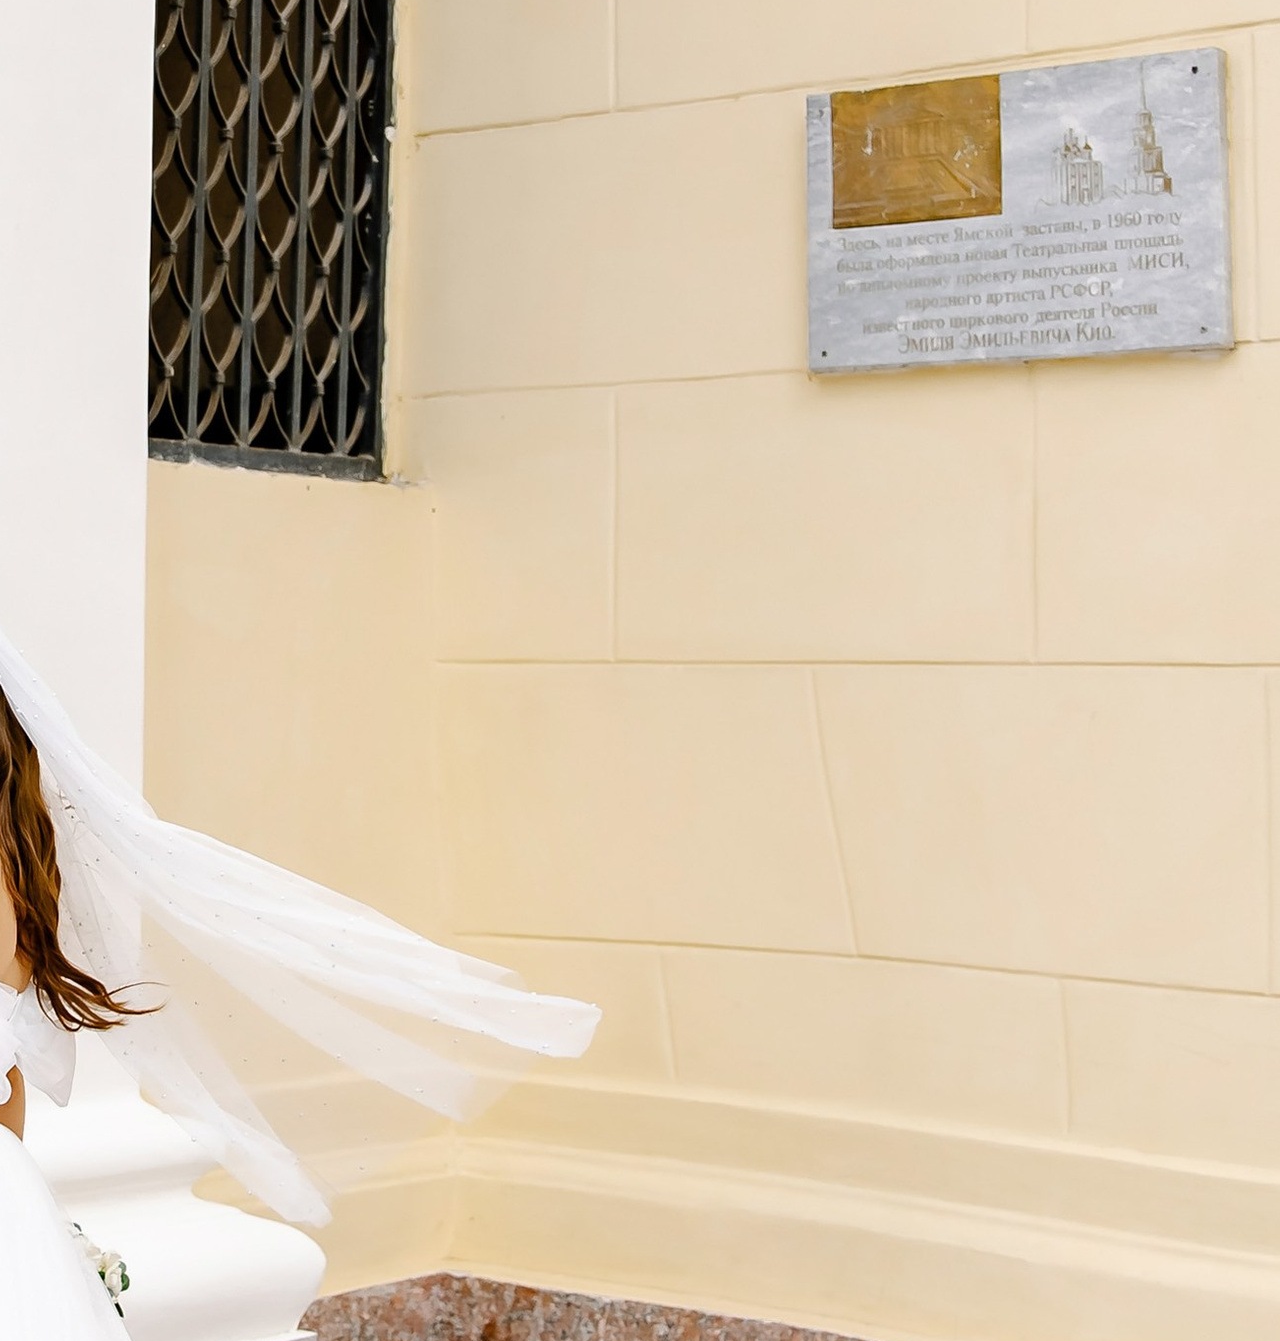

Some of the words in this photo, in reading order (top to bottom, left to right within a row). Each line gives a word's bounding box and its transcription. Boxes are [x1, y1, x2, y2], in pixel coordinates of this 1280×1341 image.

[906, 233, 950, 246] месте
[954, 227, 1013, 242] Ямской
[1093, 219, 1101, 230] в
[1108, 212, 1142, 228] 1960
[965, 248, 1008, 262] новая
[1012, 240, 1108, 258] Театральная
[956, 269, 1018, 287] проекту
[1022, 261, 1117, 280] выпускника
[986, 289, 1046, 309] артиста
[1101, 302, 1158, 318] России
